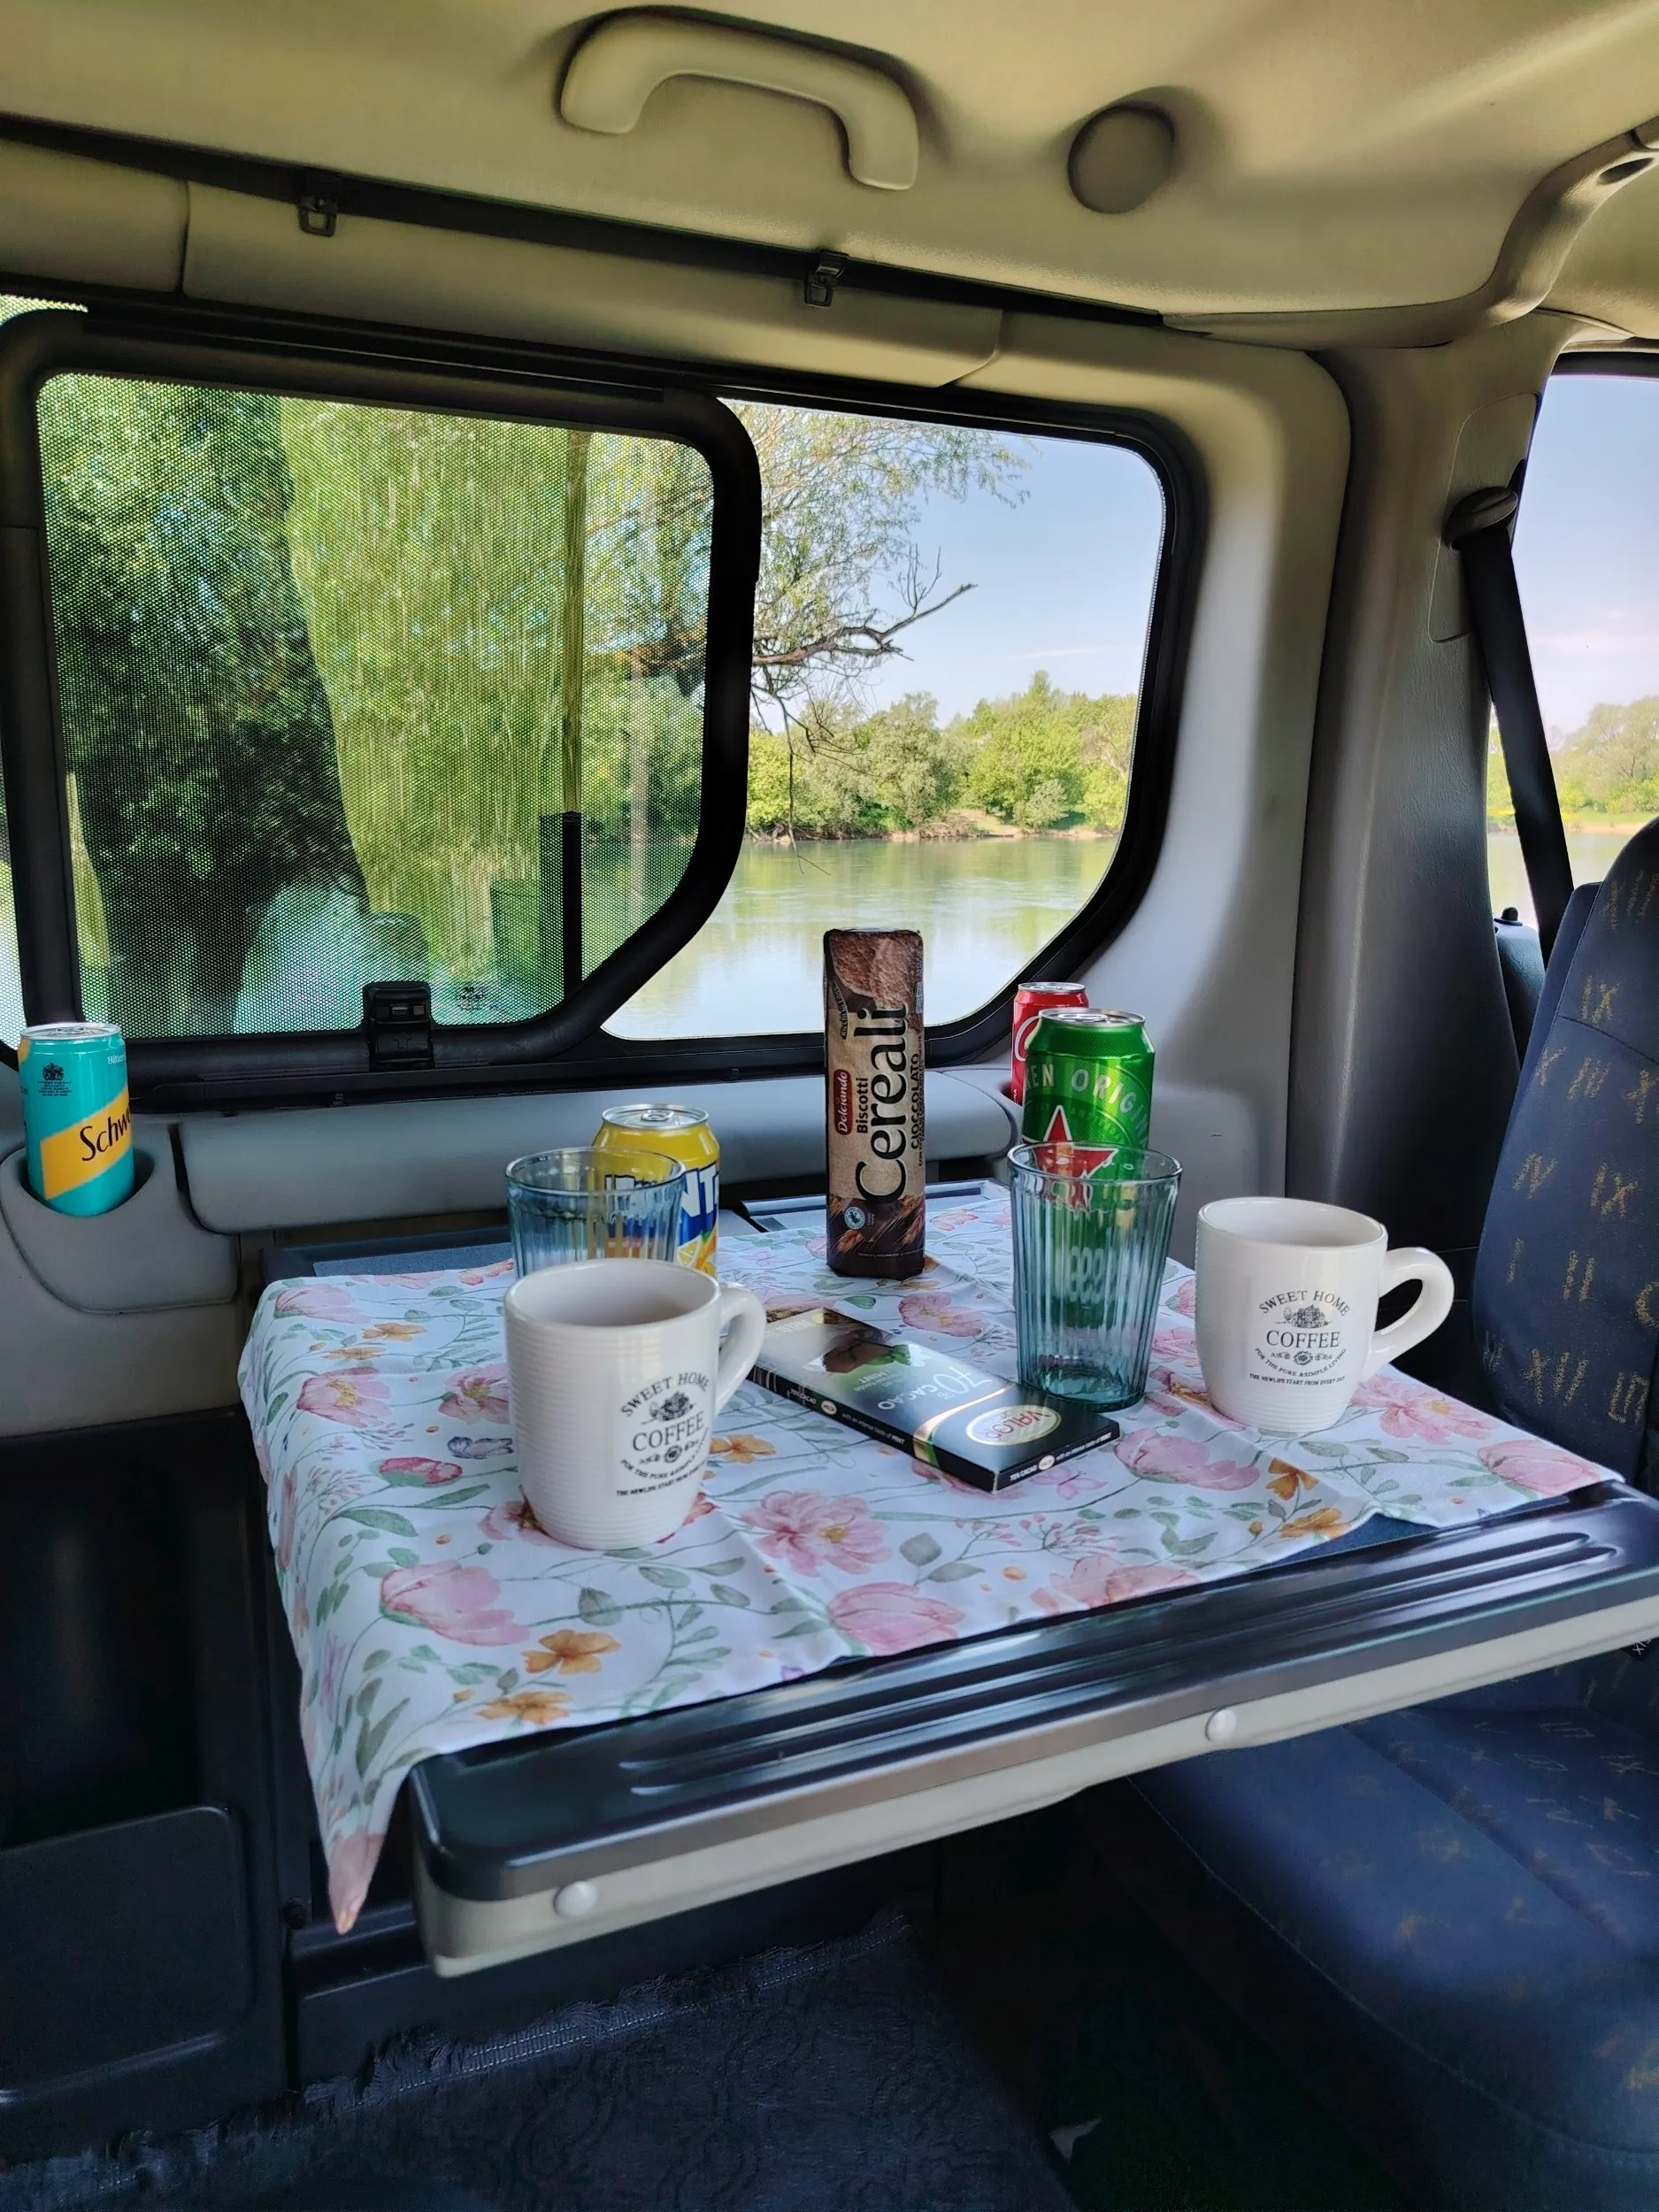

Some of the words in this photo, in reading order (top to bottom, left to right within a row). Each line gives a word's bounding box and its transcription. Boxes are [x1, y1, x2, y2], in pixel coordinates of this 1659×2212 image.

[837, 1071, 848, 1133] Dolciando
[854, 1002, 910, 1206] Cereali
[856, 1078, 868, 1133] Biscotti
[910, 1053, 919, 1149] CIOCCOLATO
[1259, 1290, 1308, 1314] SWEET
[1313, 1290, 1350, 1317] HOME
[1266, 1330, 1340, 1348] COFFEE
[1255, 1348, 1265, 1361] FOR
[1265, 1358, 1280, 1371] THE
[1279, 1367, 1297, 1377] PURE
[621, 1376, 673, 1417] SWEET
[678, 1371, 710, 1392] HOME
[633, 1410, 704, 1452] COFFEE
